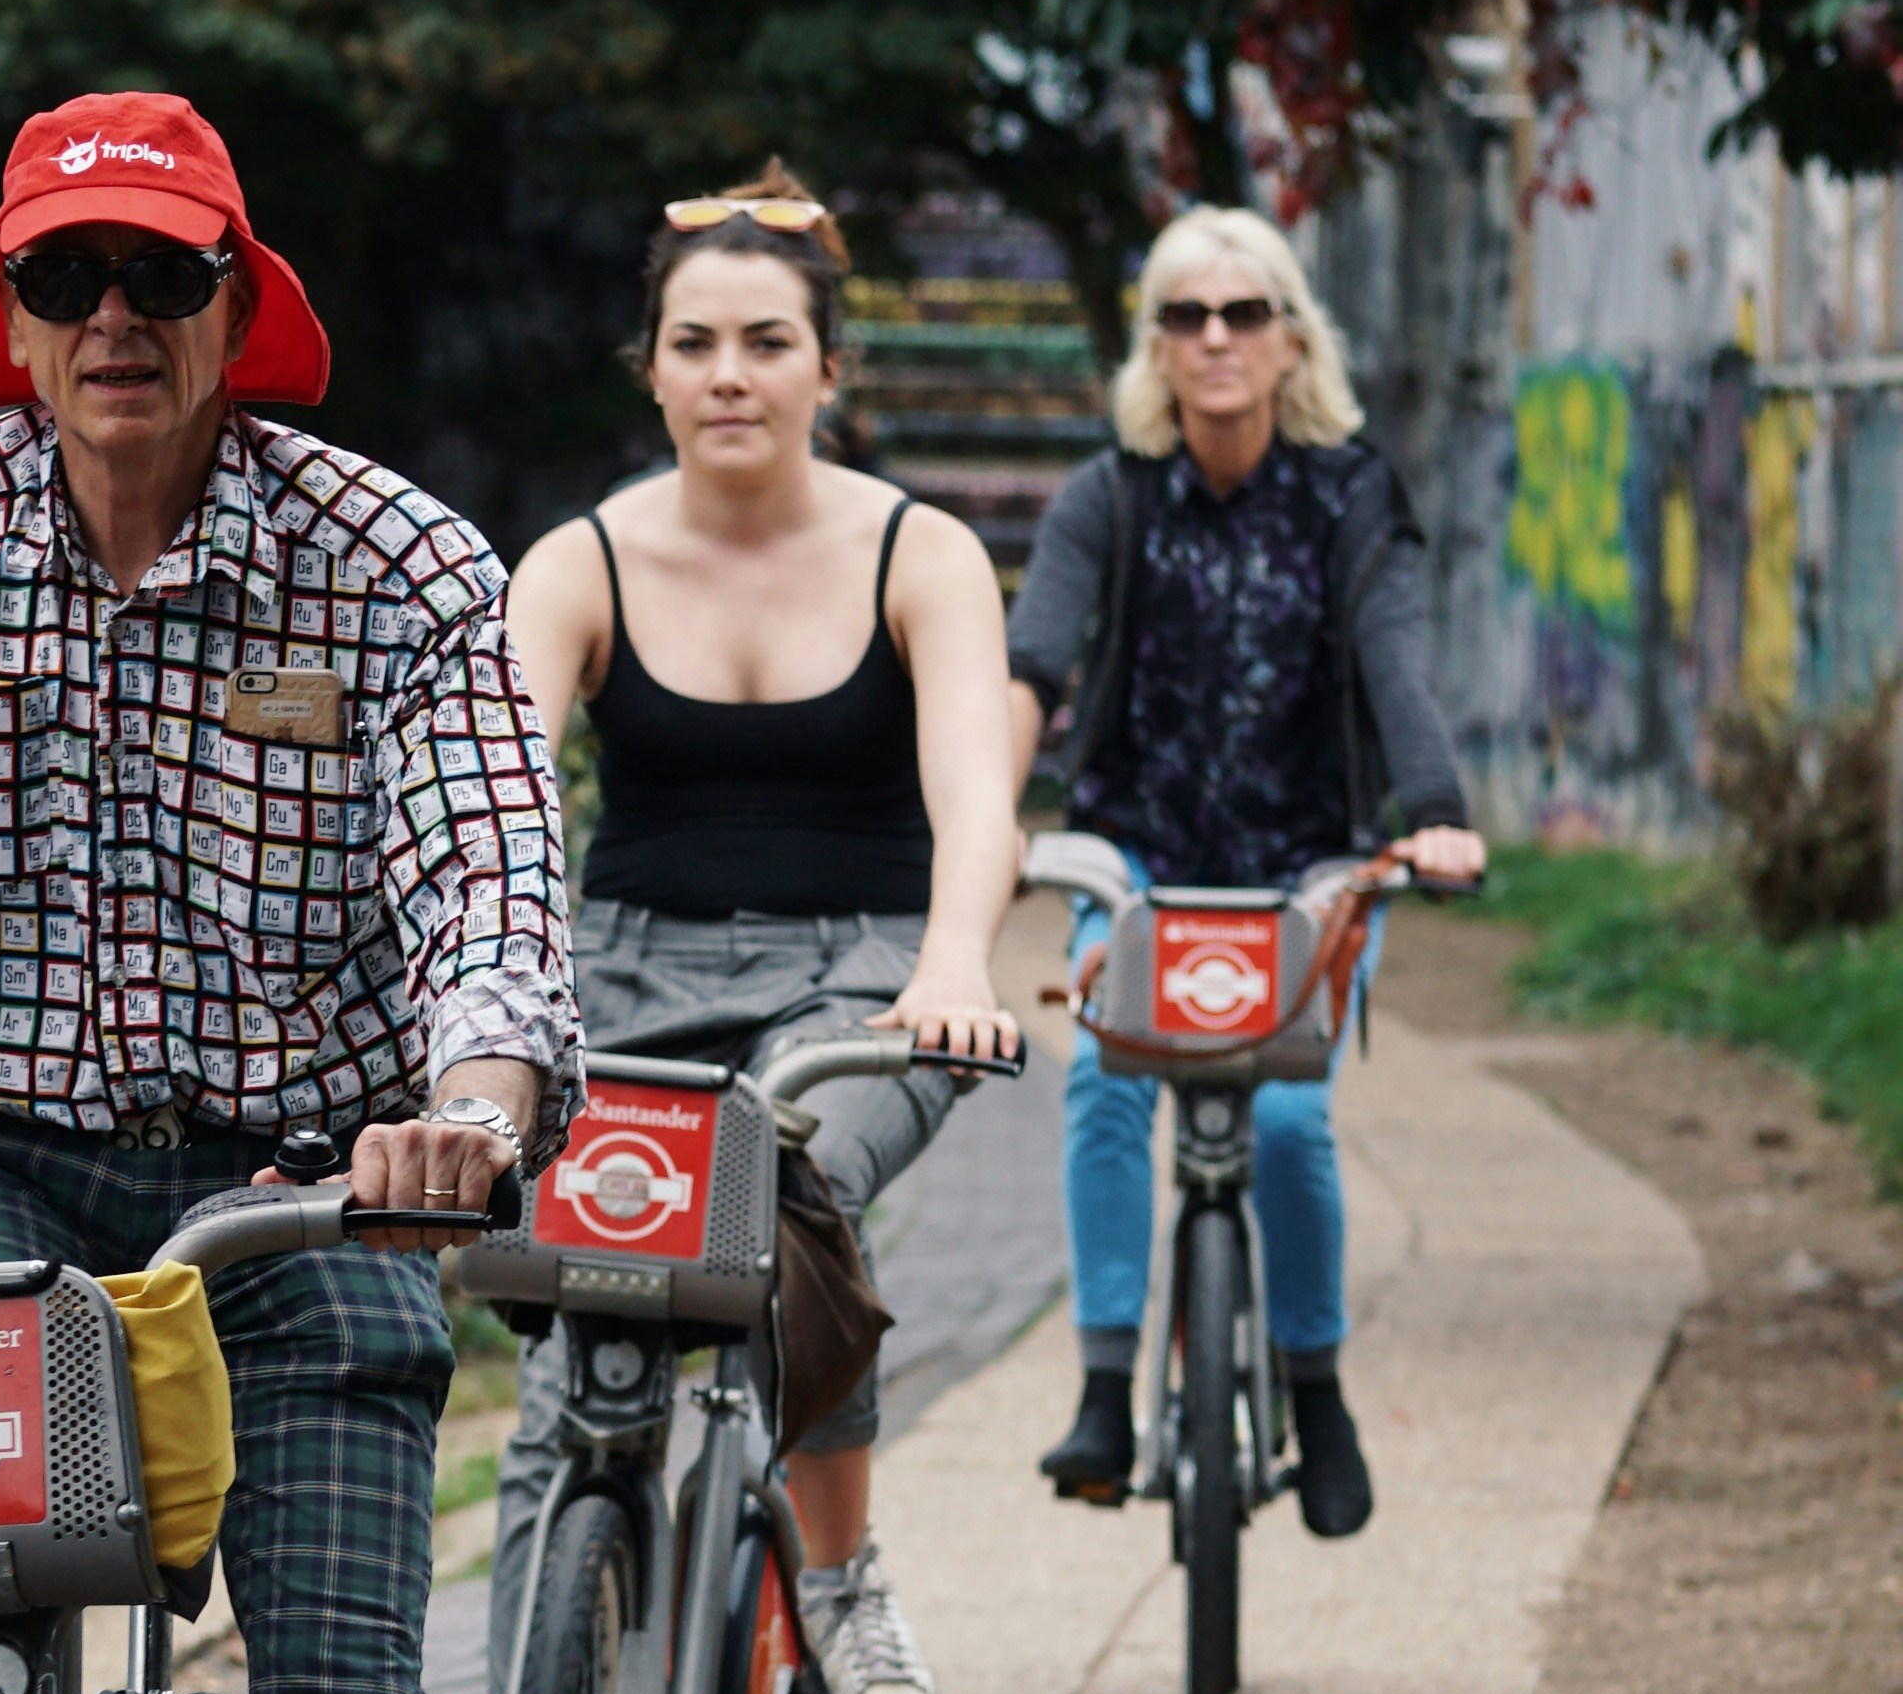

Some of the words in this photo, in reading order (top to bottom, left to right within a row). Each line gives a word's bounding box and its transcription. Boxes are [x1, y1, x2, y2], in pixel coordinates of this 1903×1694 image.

[304, 476, 326, 492] Np
[339, 500, 362, 518] Cd
[297, 555, 312, 574] Ga
[294, 602, 311, 623] Ru
[336, 607, 352, 628] Ge
[372, 610, 386, 630] Eu
[397, 612, 412, 630] Br
[124, 624, 140, 646] Ag
[167, 628, 184, 646] Ar
[207, 634, 222, 655] Sn
[2, 642, 14, 662] Ta
[246, 644, 262, 664] Cd
[366, 658, 380, 679] Lu
[476, 663, 490, 682] Mo
[125, 669, 139, 688] Tb
[166, 675, 176, 696] Ta
[205, 683, 218, 704] As
[124, 716, 140, 734] Os
[480, 708, 500, 724] Am
[159, 723, 170, 743] Cf
[224, 743, 231, 762] Y
[442, 748, 462, 764] Rb
[122, 763, 136, 781] At
[270, 754, 286, 774] Ga
[316, 760, 326, 779] U
[196, 780, 208, 800] Lr
[452, 786, 470, 800] Pb
[497, 784, 514, 796] Sr
[226, 792, 242, 816] Np
[268, 802, 286, 823] Ru
[413, 802, 422, 820] P
[318, 808, 335, 828] Ge
[192, 828, 208, 850] No
[512, 839, 534, 854] Tm
[26, 842, 40, 860] Ta
[226, 840, 240, 862] Cd
[126, 857, 142, 874] He
[266, 852, 288, 872] Cm
[315, 858, 324, 876] O
[350, 862, 364, 878] Lu
[48, 878, 64, 896] Fe
[192, 872, 200, 890] H
[126, 902, 138, 922] Si
[262, 900, 280, 920] Ho
[310, 906, 322, 924] W
[5, 918, 21, 938] Pa
[50, 920, 66, 940] Na
[468, 914, 482, 928] Th
[126, 950, 142, 967] Zn
[165, 954, 180, 974] Pa
[366, 956, 382, 972] Br
[4, 965, 26, 984] Sm
[50, 969, 64, 988] Tc
[128, 994, 146, 1016] Mg
[386, 995, 400, 1012] K
[3, 1012, 18, 1032] Ar
[207, 1006, 222, 1026] Tc
[244, 1012, 262, 1034] Np
[46, 1016, 62, 1036] Sn
[346, 1019, 365, 1036] Lu
[173, 1042, 188, 1061] Ar
[204, 1055, 220, 1076] Sn
[247, 1058, 264, 1078] Cd
[368, 1058, 382, 1075] Kr
[328, 1074, 340, 1094] W
[286, 1094, 306, 1113] Ho
[587, 1095, 703, 1132] Santander
